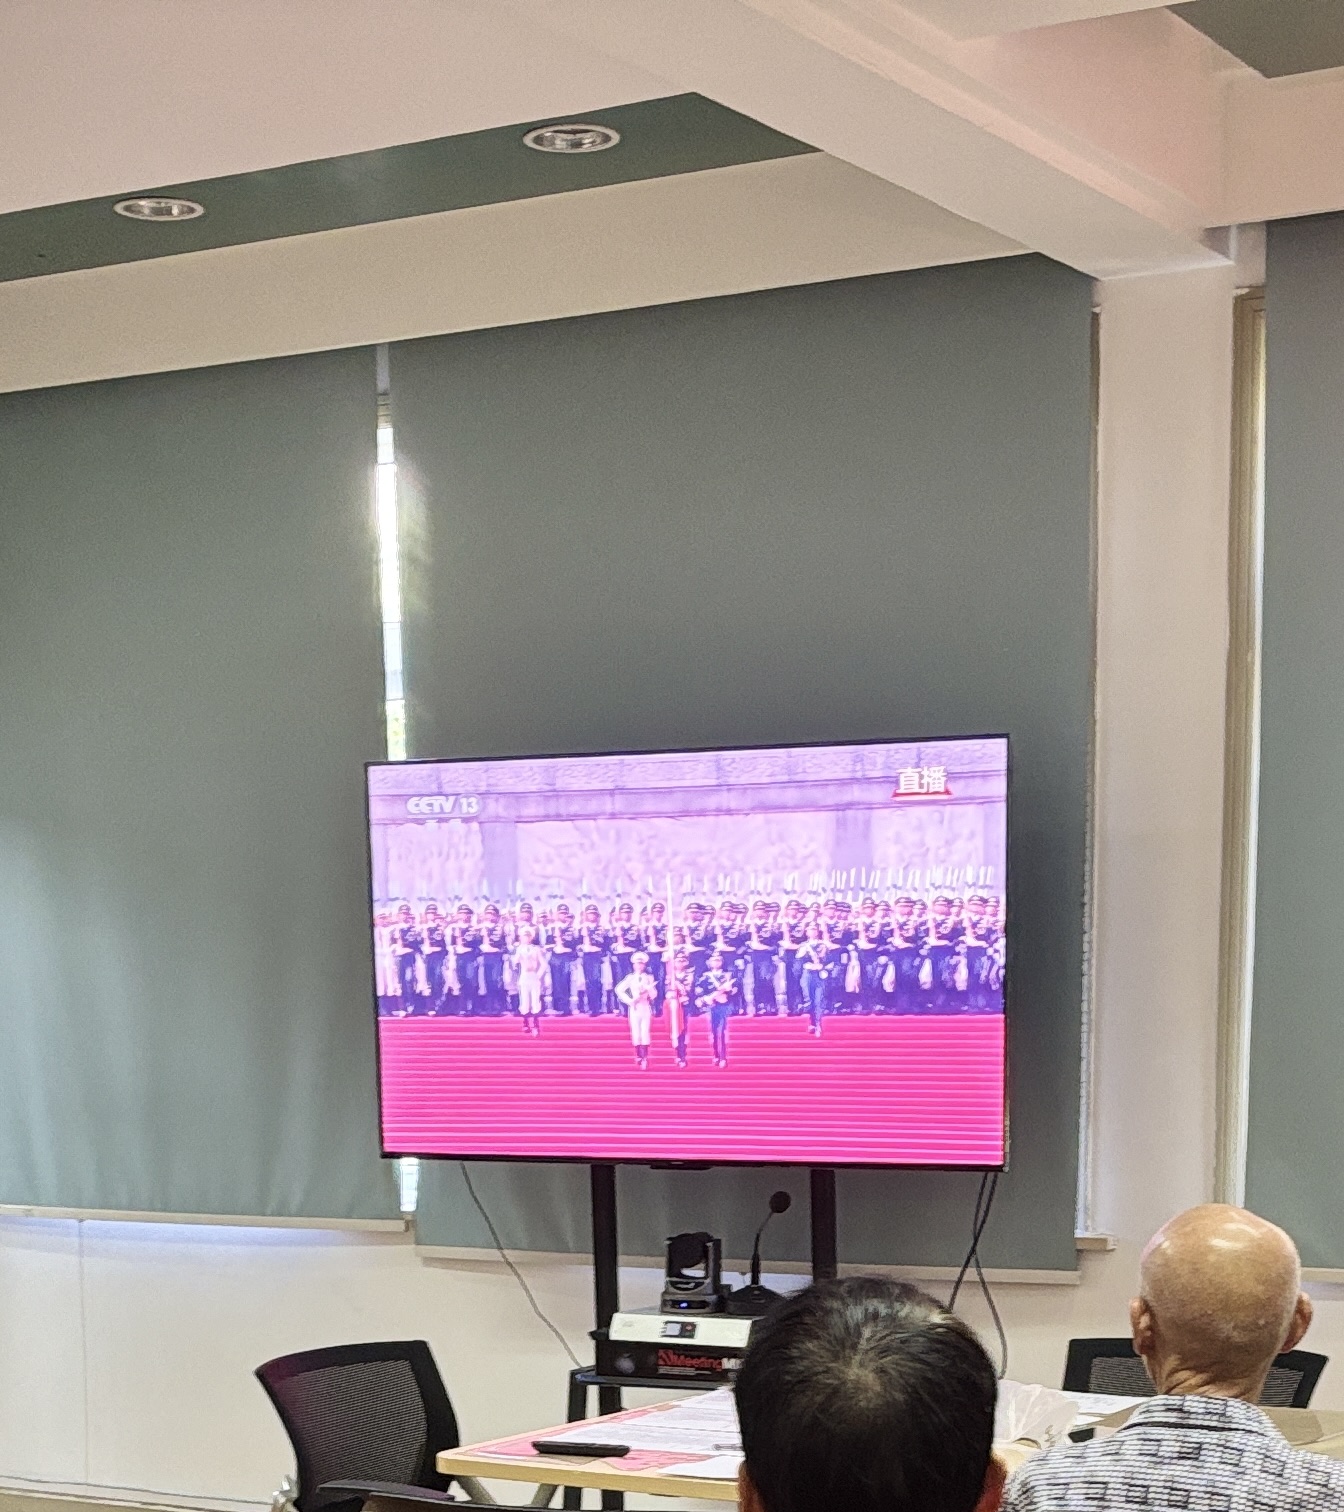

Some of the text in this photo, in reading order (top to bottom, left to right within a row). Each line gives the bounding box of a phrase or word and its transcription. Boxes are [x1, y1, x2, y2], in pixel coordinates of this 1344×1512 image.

[895, 766, 948, 793] 直播
[406, 795, 479, 814] CCTV 13
